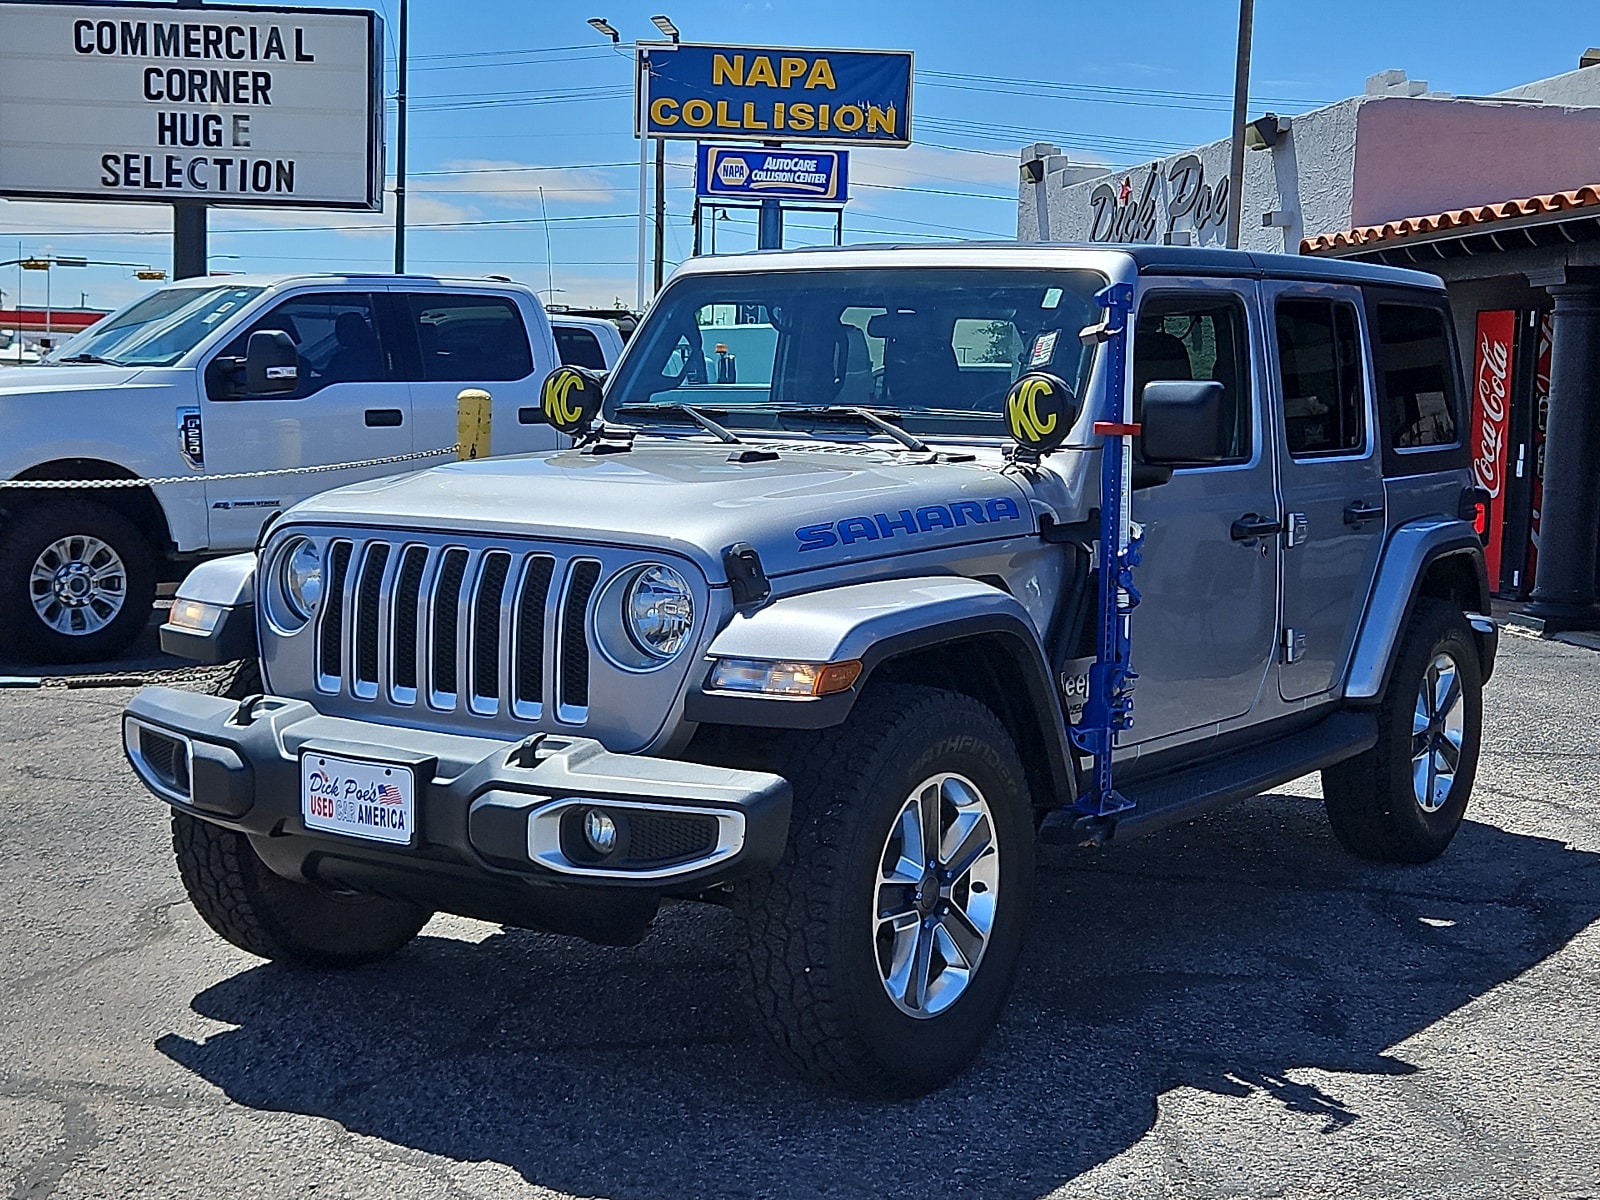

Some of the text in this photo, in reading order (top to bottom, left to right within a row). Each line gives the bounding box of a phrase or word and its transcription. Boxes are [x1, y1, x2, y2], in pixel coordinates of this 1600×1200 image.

[73, 19, 315, 62] COMMERCIAL
[143, 67, 272, 105] CORNER
[712, 54, 836, 90] NAPA
[157, 112, 251, 148] HUGE
[650, 98, 896, 134] COLLISION
[101, 154, 295, 193] SELECTION
[722, 164, 745, 178] NAPA
[751, 169, 827, 184] COLLISION CENTER
[1090, 161, 1158, 243] Dick
[545, 371, 585, 426] KC
[1008, 379, 1057, 442] KC
[1474, 331, 1508, 498] Coca-Cola
[795, 496, 1020, 553] SAHARA
[309, 772, 378, 803] Dick Poe's
[310, 795, 405, 830] USED CAR AMERICA
